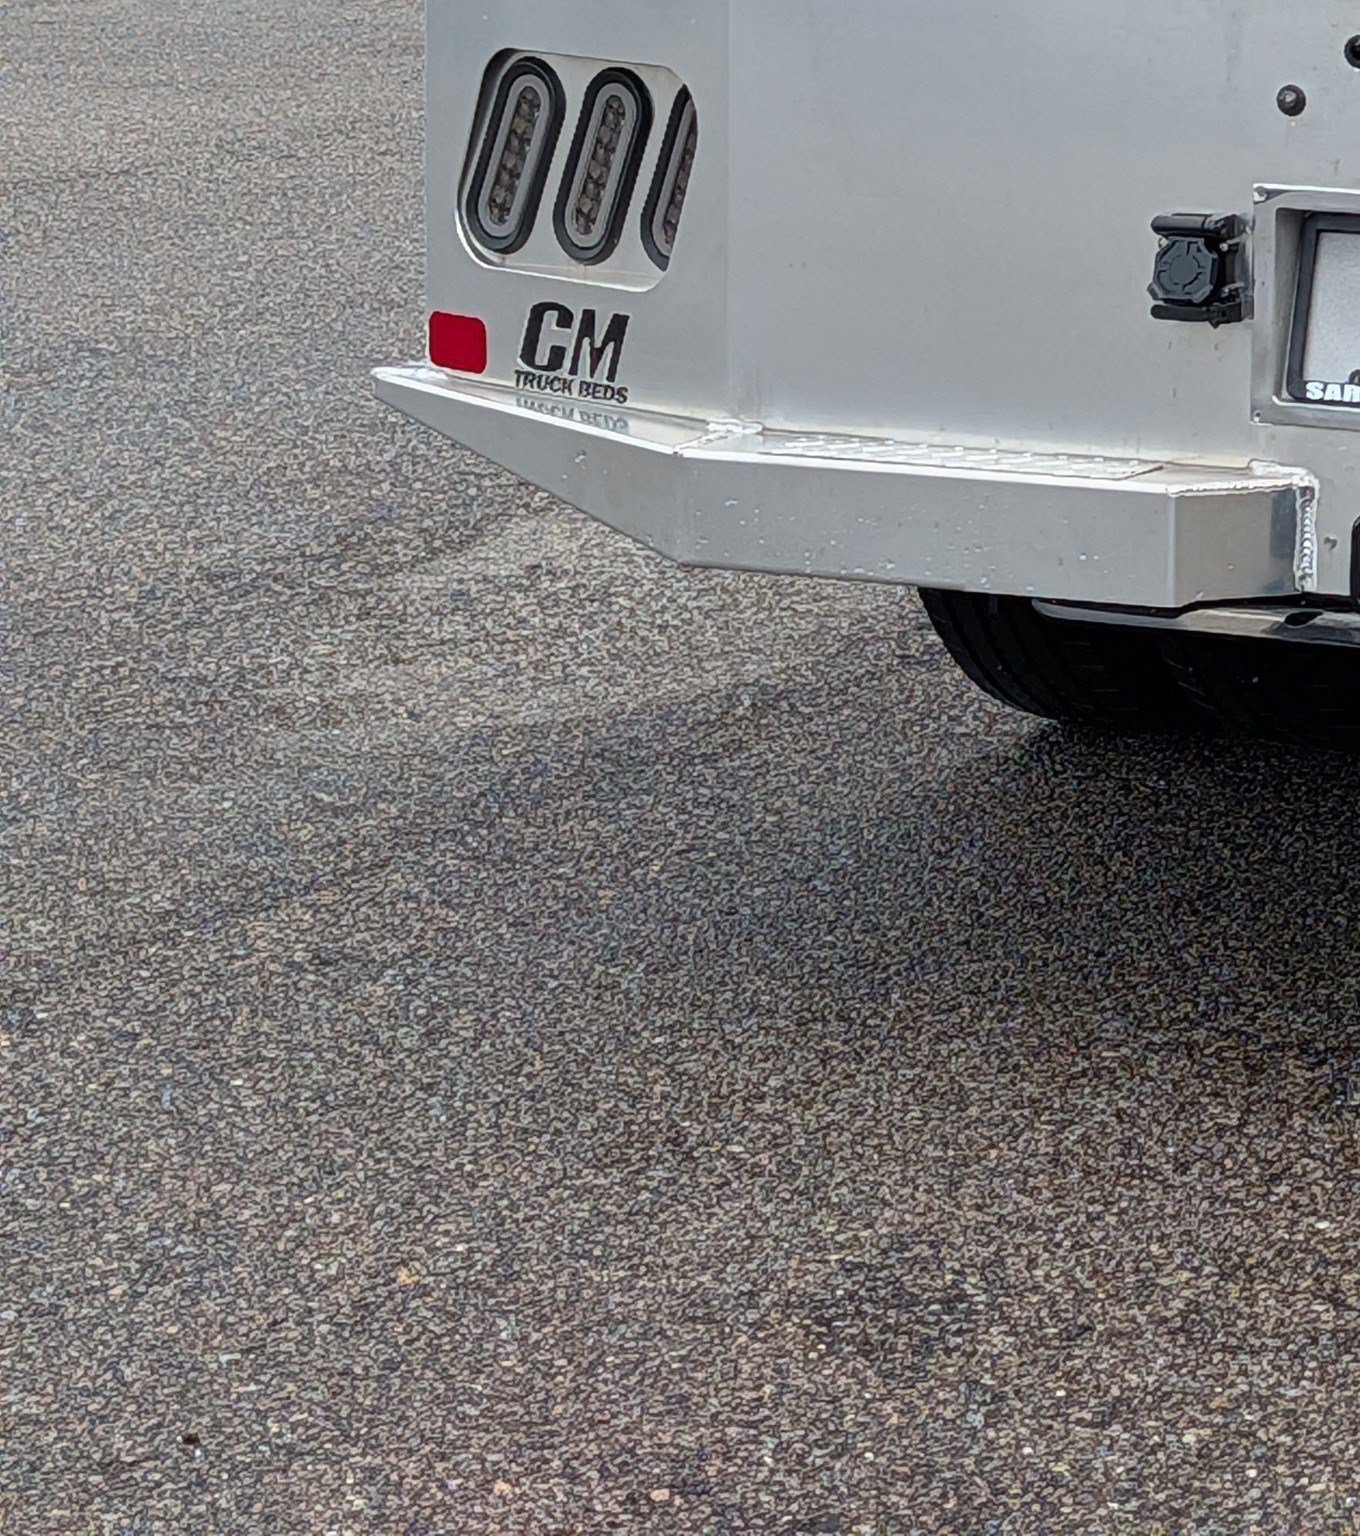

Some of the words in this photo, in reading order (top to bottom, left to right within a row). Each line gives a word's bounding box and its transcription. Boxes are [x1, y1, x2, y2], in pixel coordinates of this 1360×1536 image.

[518, 301, 631, 383] CM
[514, 368, 575, 397] TRUCK
[577, 379, 629, 404] BEDS
